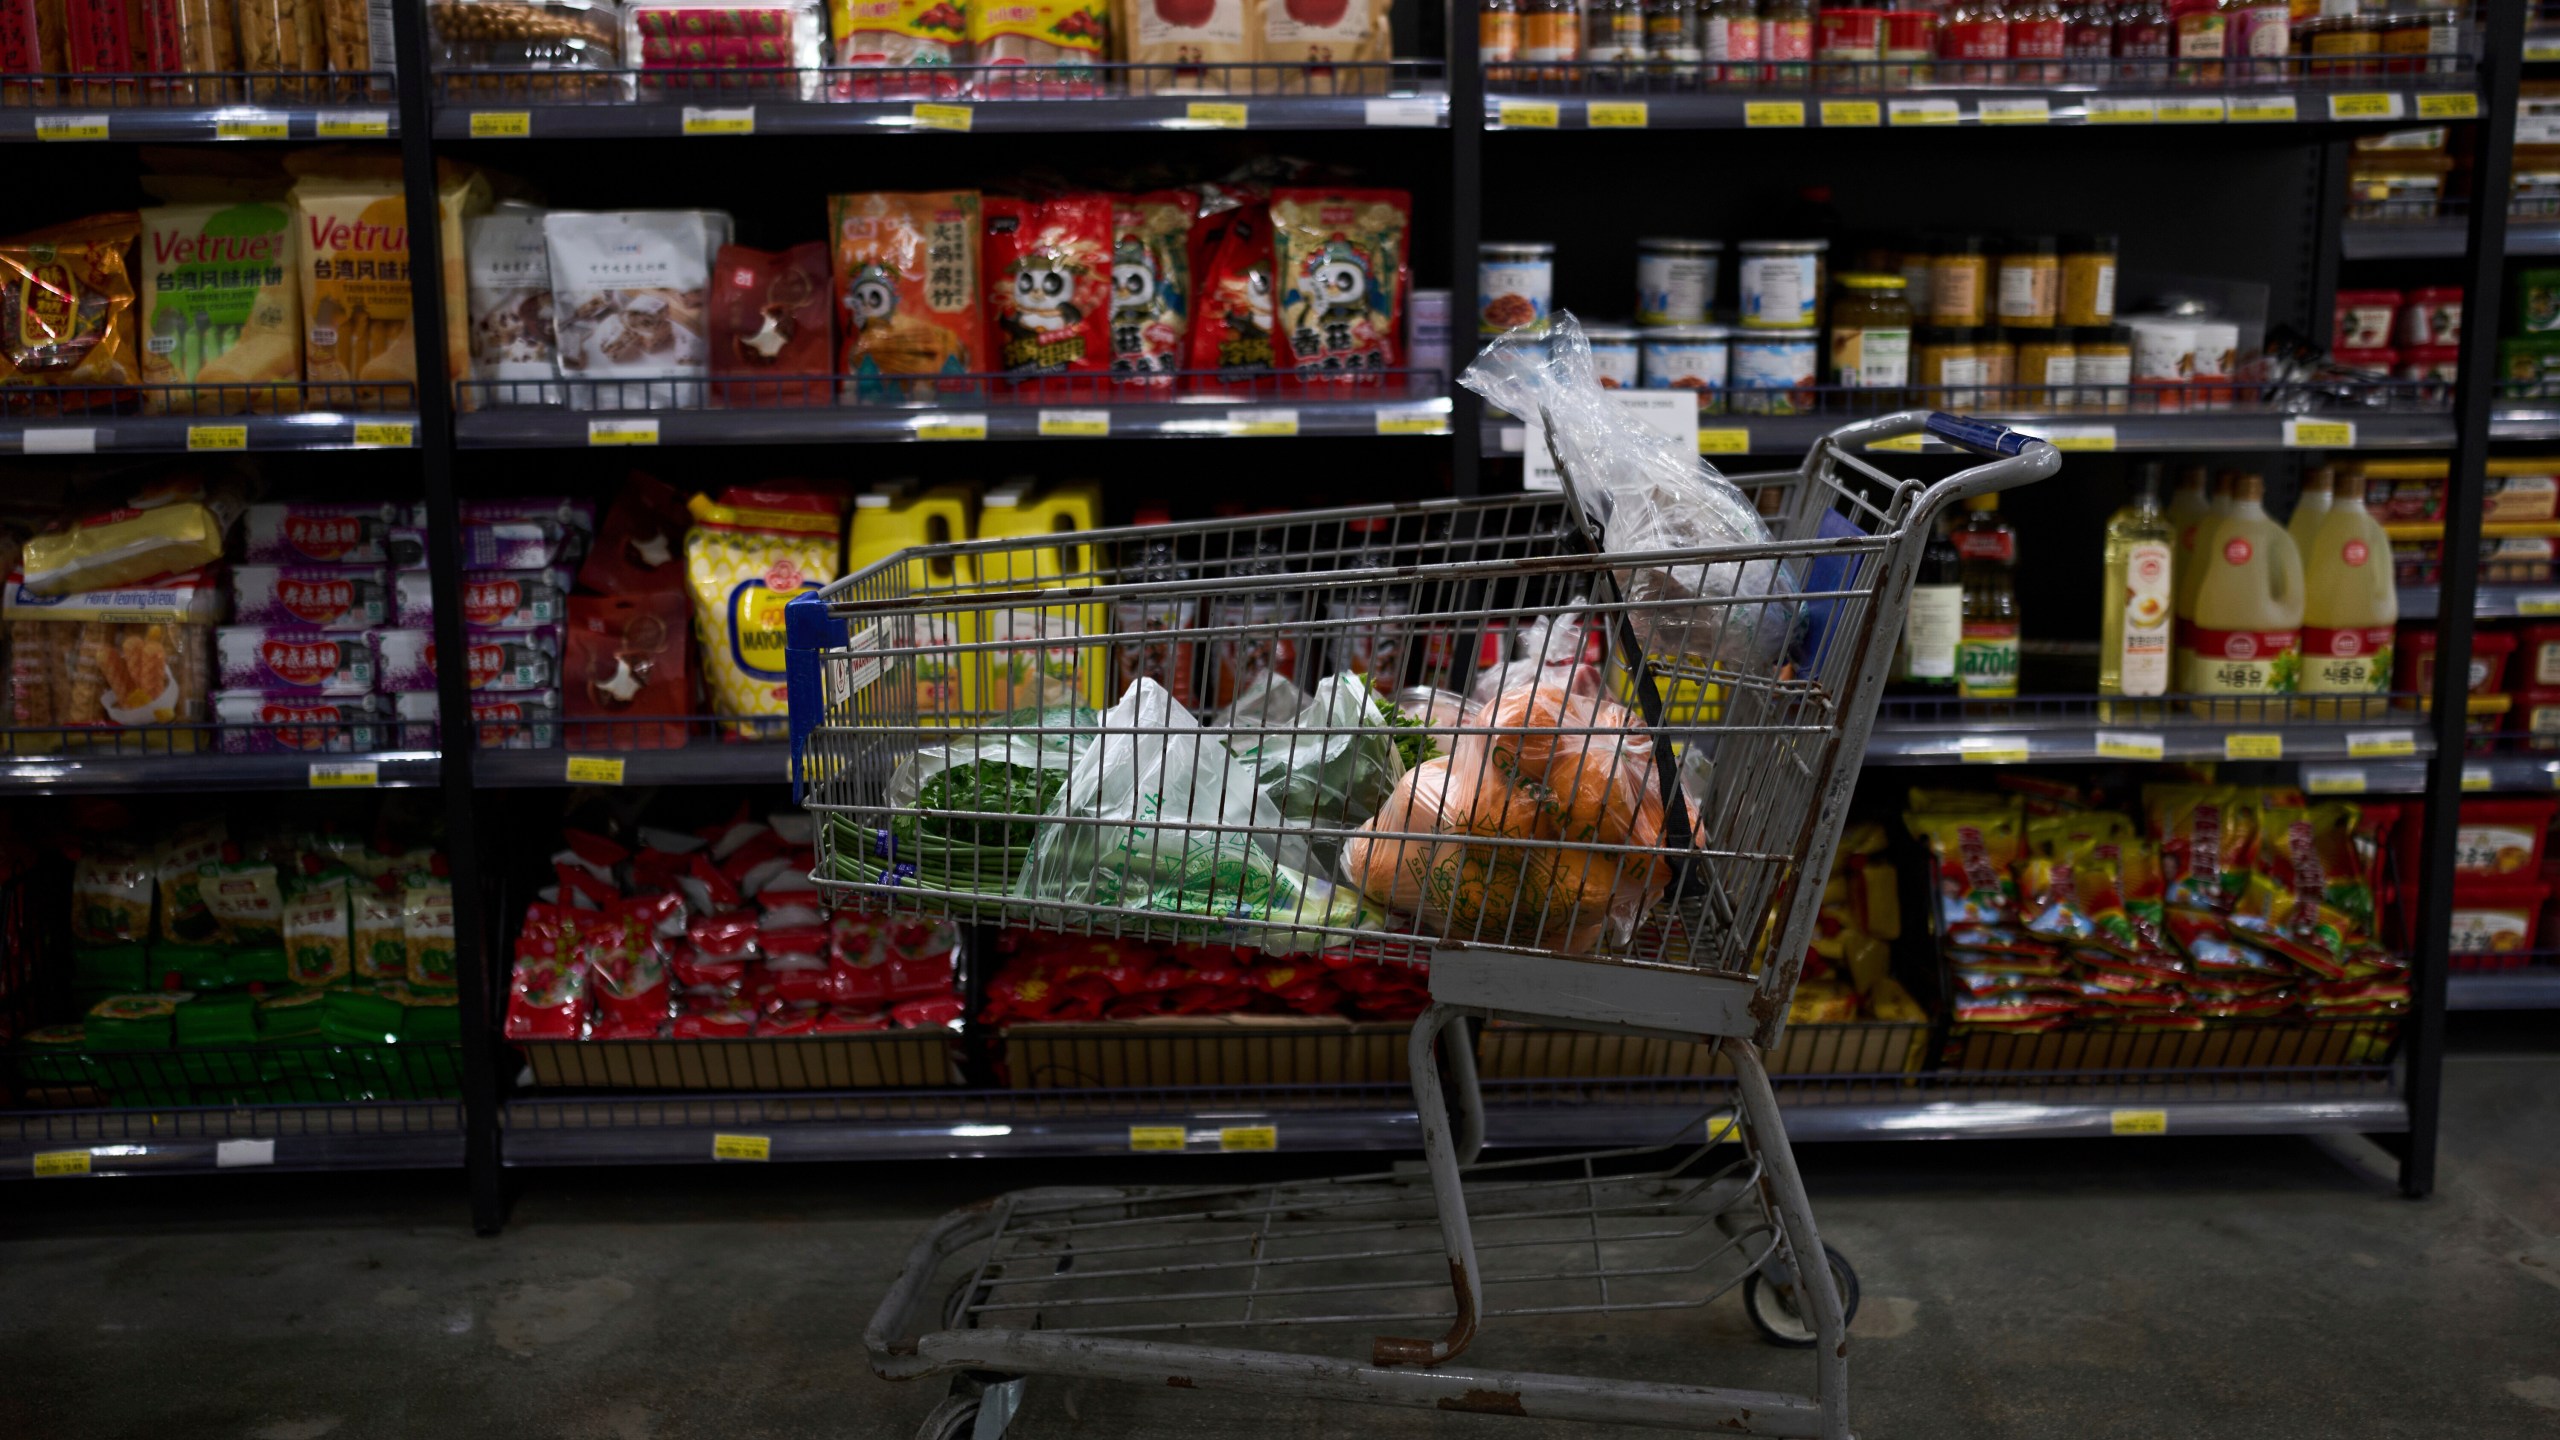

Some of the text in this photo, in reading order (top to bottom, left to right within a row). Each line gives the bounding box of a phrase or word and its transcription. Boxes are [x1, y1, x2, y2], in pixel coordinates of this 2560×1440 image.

[153, 230, 269, 264] Vetrue
[310, 214, 410, 252] Vetru
[1962, 646, 2019, 676] azola
